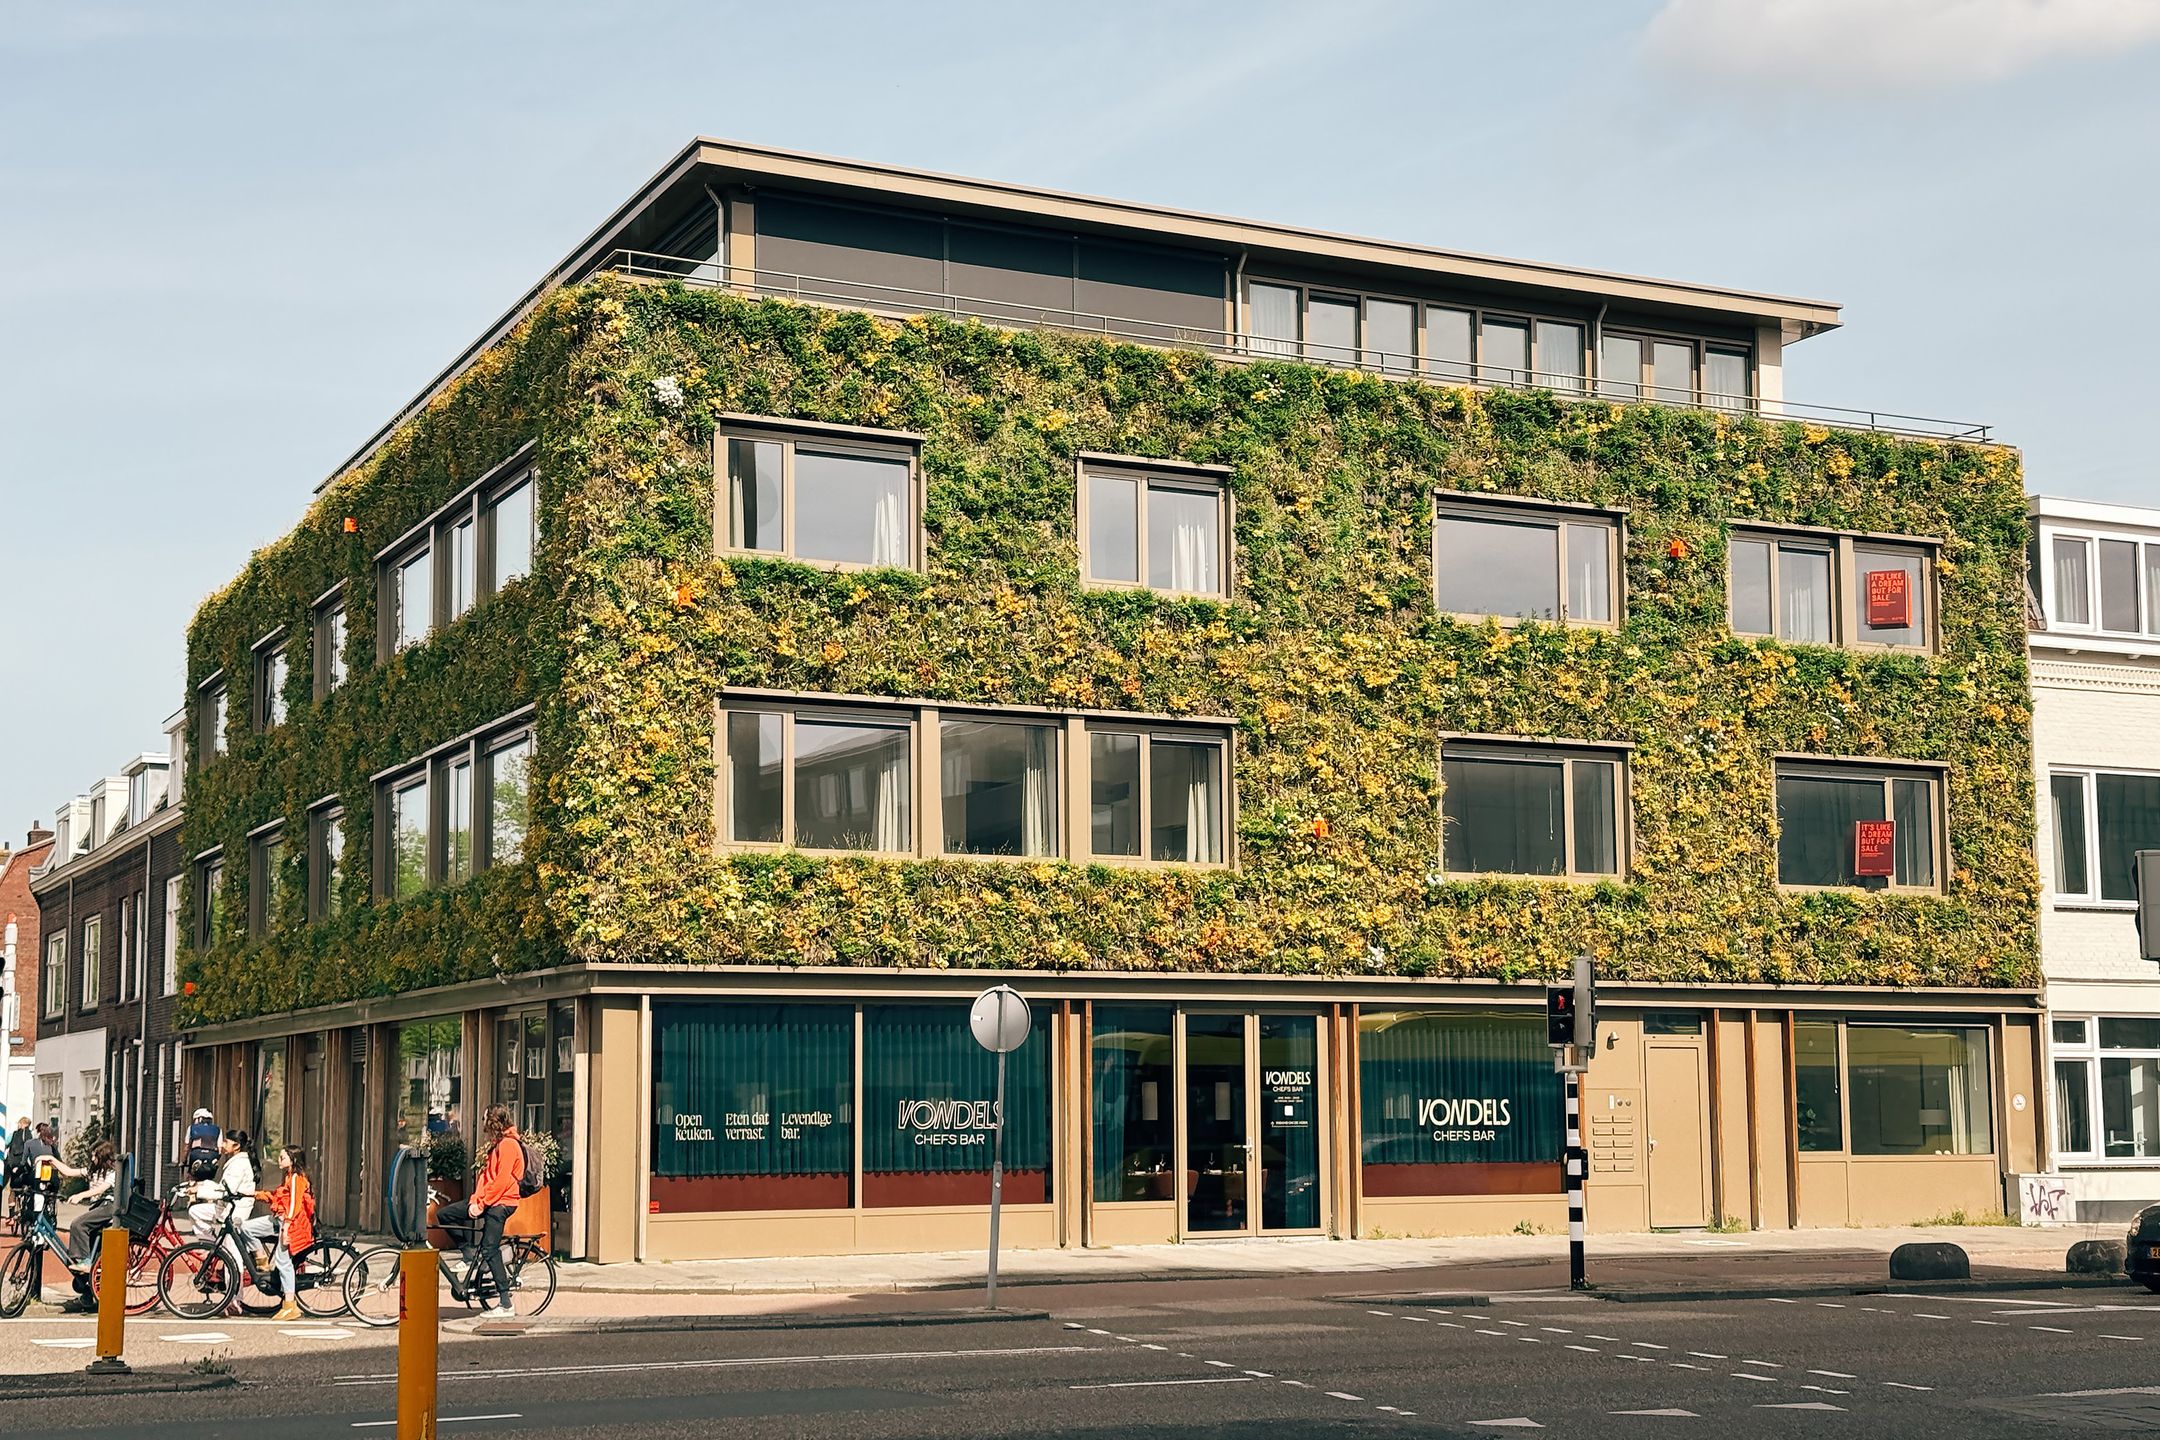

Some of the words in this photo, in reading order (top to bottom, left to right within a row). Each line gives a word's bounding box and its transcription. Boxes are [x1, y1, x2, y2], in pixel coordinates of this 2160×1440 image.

[1886, 572, 1902, 580] LIKE
[1265, 1071, 1311, 1085] VONDELS
[725, 1113, 750, 1126] Eten
[752, 1112, 769, 1126] dat
[781, 1111, 832, 1127] Levendige
[898, 1100, 1004, 1130] VONDELS
[1418, 1098, 1511, 1126] VONDELS
[675, 1113, 703, 1130] Open
[675, 1127, 715, 1141] keuken.
[725, 1127, 766, 1140] verrast.
[781, 1126, 801, 1140] bar.
[914, 1133, 958, 1145] CHEFS
[959, 1133, 985, 1145] BAR
[1433, 1130, 1471, 1141] CHEFS
[1472, 1130, 1496, 1141] BAR
